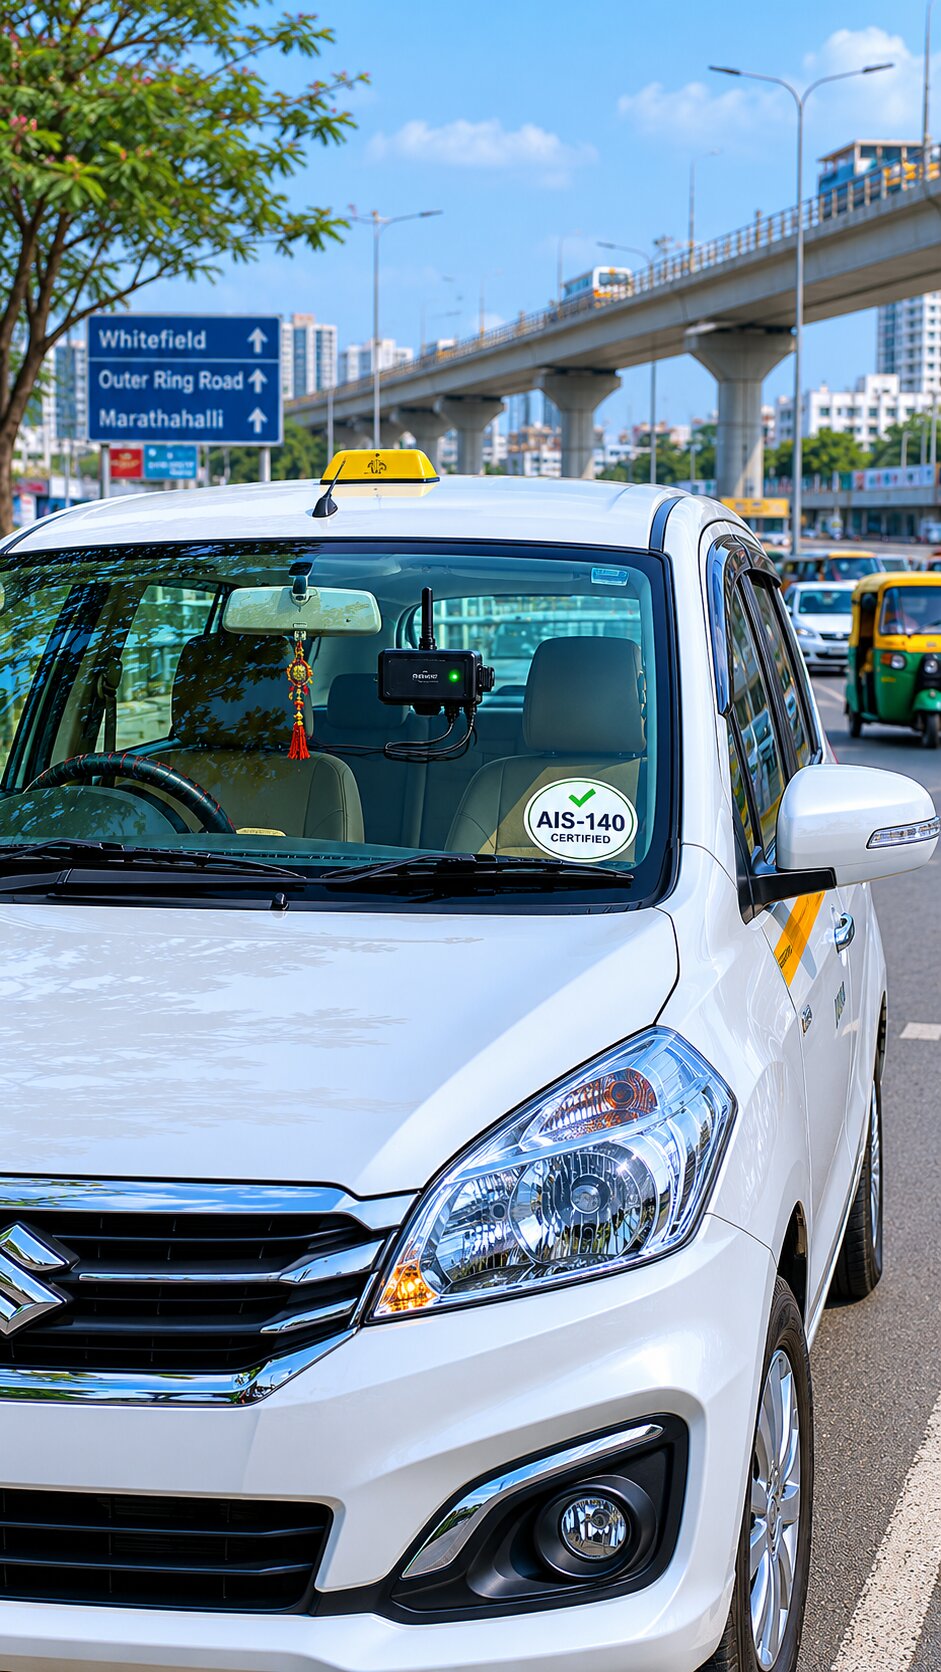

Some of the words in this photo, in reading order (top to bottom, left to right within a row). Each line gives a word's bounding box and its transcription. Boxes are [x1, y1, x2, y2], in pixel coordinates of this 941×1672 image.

[99, 329, 206, 349] Whitefield
[99, 370, 149, 389] Outer
[154, 370, 194, 394] Ring
[199, 371, 244, 390] Road
[99, 409, 223, 429] Marathahalli
[536, 811, 626, 832] AIS-140
[550, 833, 611, 844] CERTIFIED
